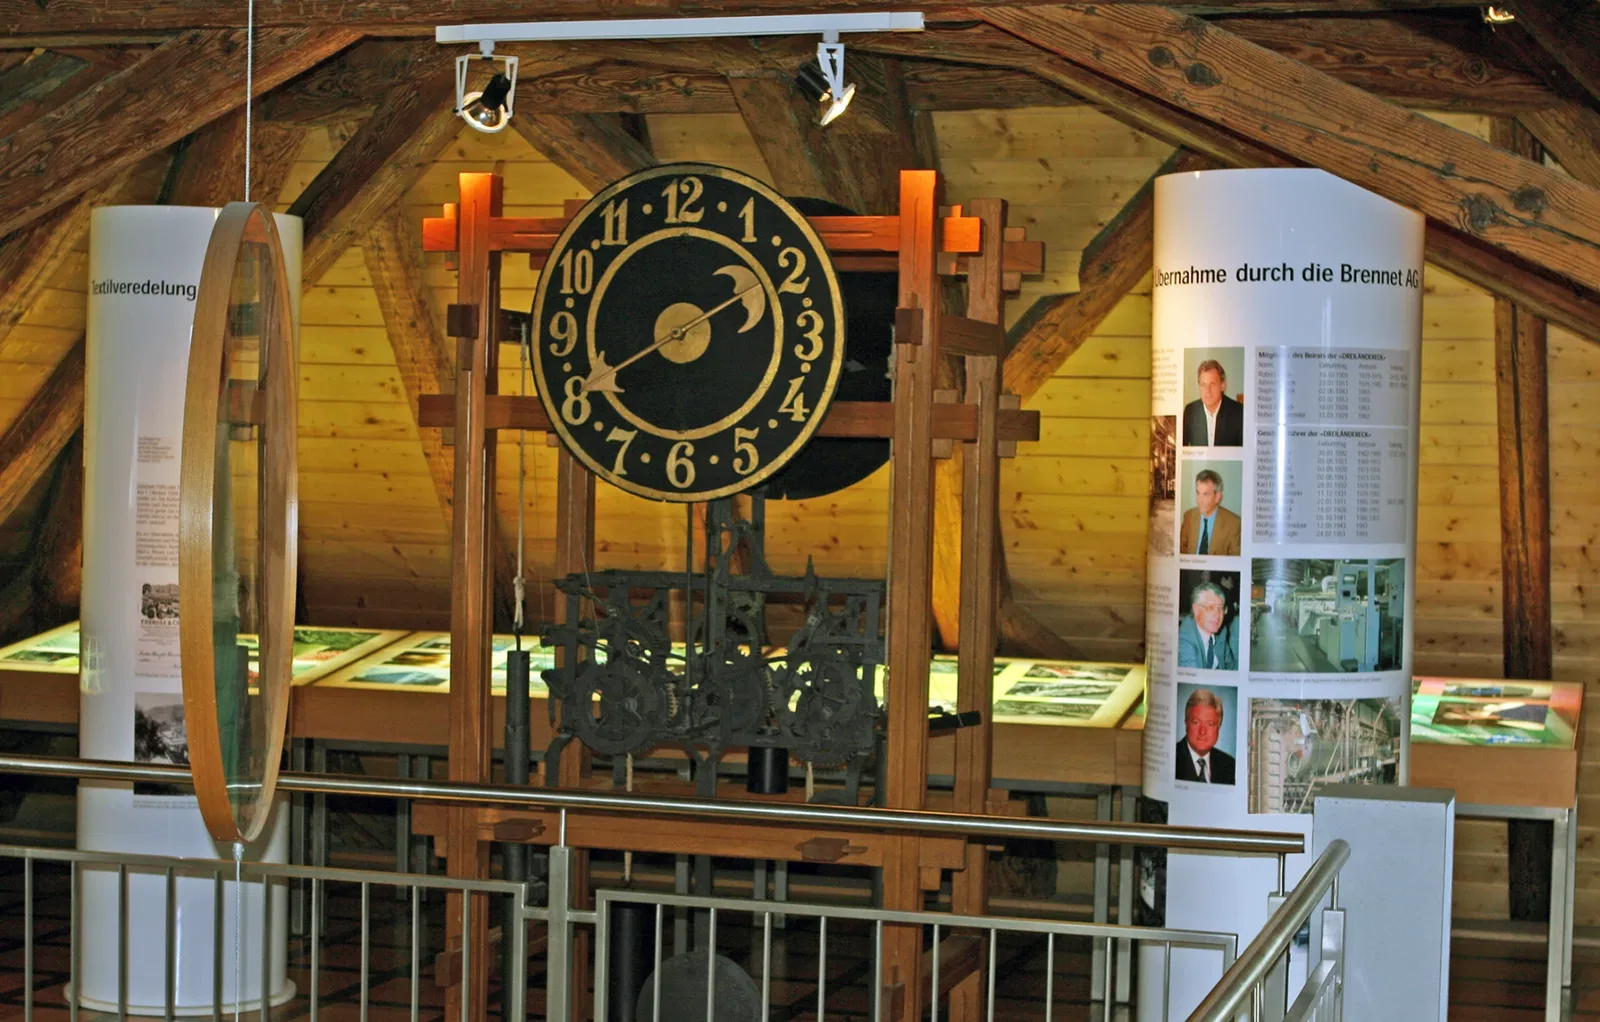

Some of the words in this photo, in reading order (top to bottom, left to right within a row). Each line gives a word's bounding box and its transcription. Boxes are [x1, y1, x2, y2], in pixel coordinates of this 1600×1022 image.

[600, 198, 628, 246] 11
[661, 176, 705, 224] 12
[738, 196, 757, 243] 1
[559, 248, 594, 295] 10
[777, 246, 810, 295] 2
[1236, 263, 1294, 282] durch
[1302, 263, 1333, 282] die
[1341, 263, 1403, 287] Brennet
[1405, 269, 1419, 289] AG
[549, 311, 578, 357] 9
[794, 309, 824, 361] 3
[561, 375, 592, 426] 8
[777, 375, 810, 422] 4
[605, 426, 638, 476] 7
[666, 441, 696, 489] 6
[732, 427, 760, 475] 5
